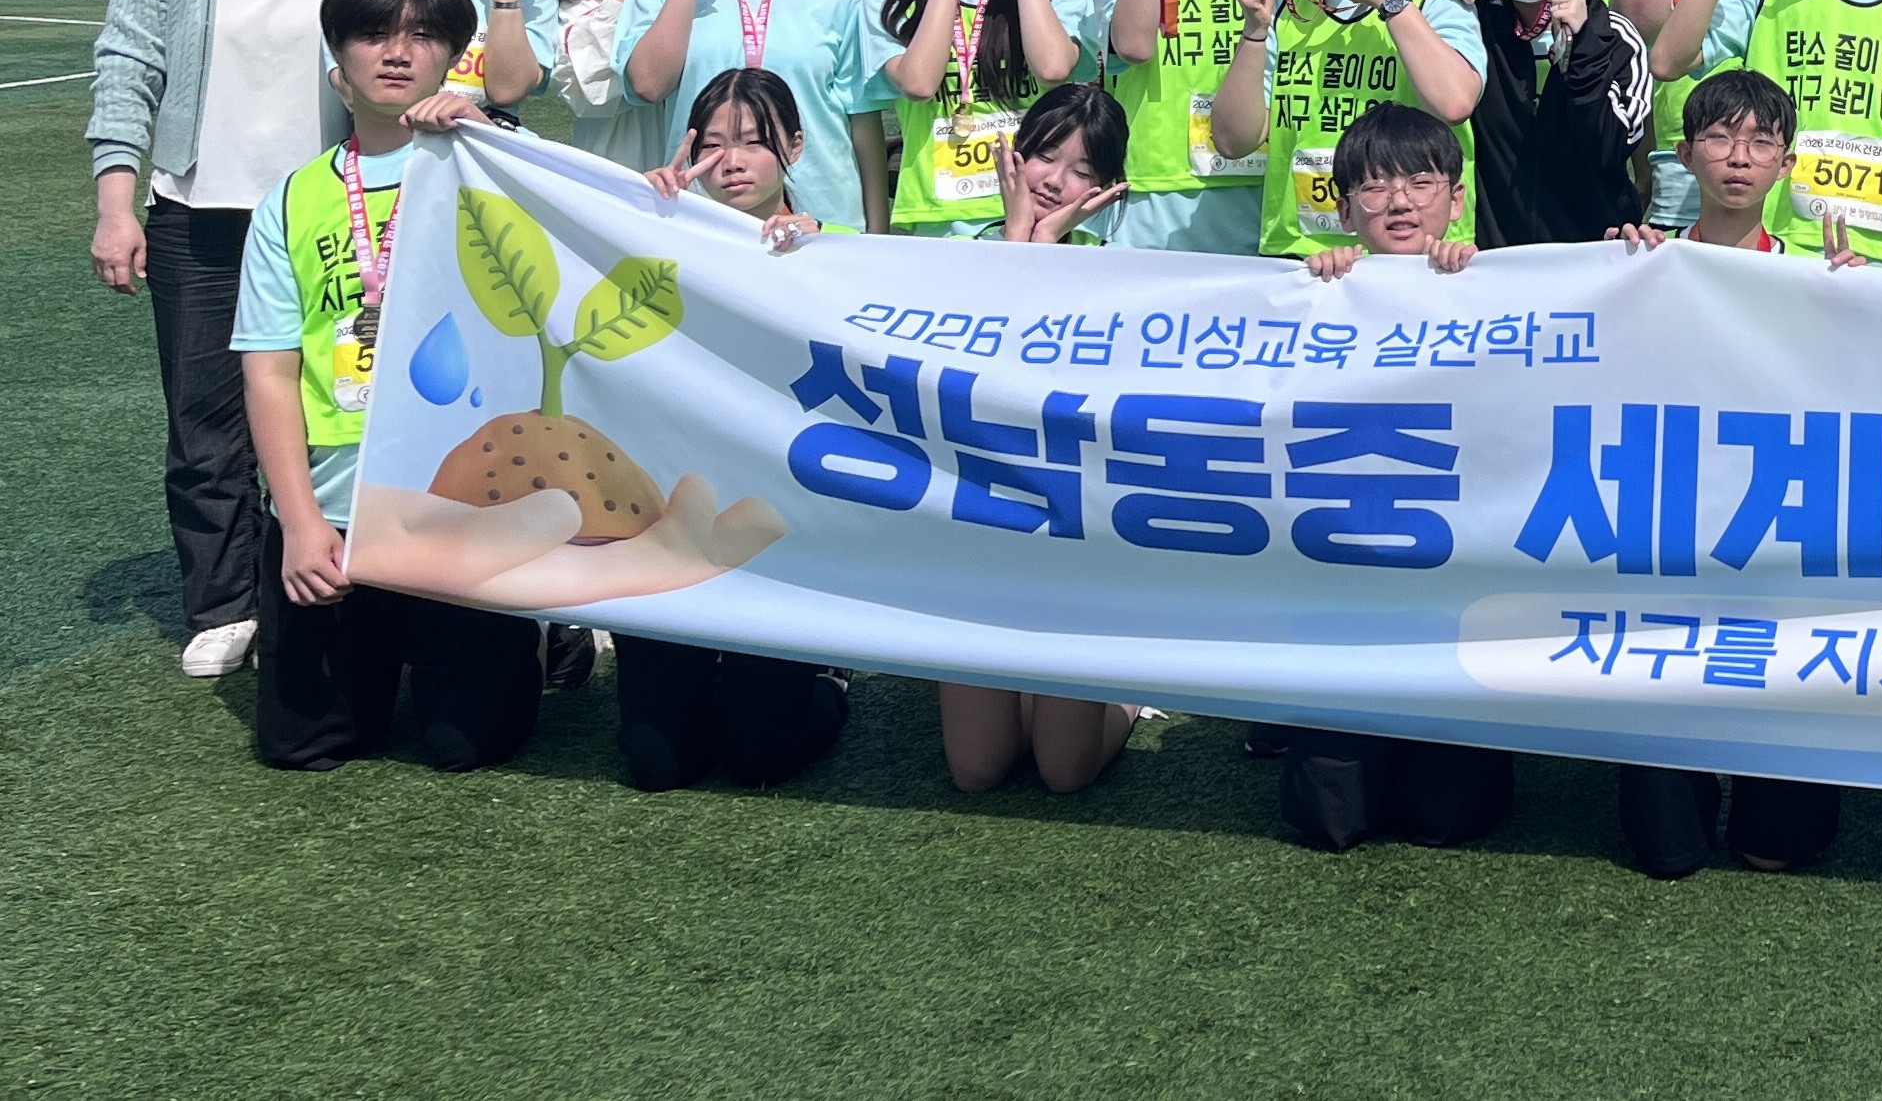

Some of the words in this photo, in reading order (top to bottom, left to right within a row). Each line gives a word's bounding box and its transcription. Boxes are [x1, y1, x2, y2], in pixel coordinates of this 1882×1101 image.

[1276, 50, 1313, 87] 탄소
[1322, 52, 1366, 90] 줄이
[1367, 55, 1397, 92] GO
[1786, 30, 1826, 68] 탄소
[1835, 33, 1880, 75] 줄이
[1274, 94, 1311, 132] 지구
[1786, 74, 1822, 112] 지구
[1829, 76, 1875, 120] 살리
[935, 125, 954, 136] 202
[1798, 138, 1824, 149] 2026
[953, 141, 992, 168] 50
[844, 303, 1008, 358] 2026
[1020, 311, 1124, 366] 성남
[1142, 312, 1358, 371] 인성교육
[1374, 311, 1600, 369] 실천학교
[785, 338, 1462, 570] 성남동중
[1548, 609, 1779, 689] 지구를
